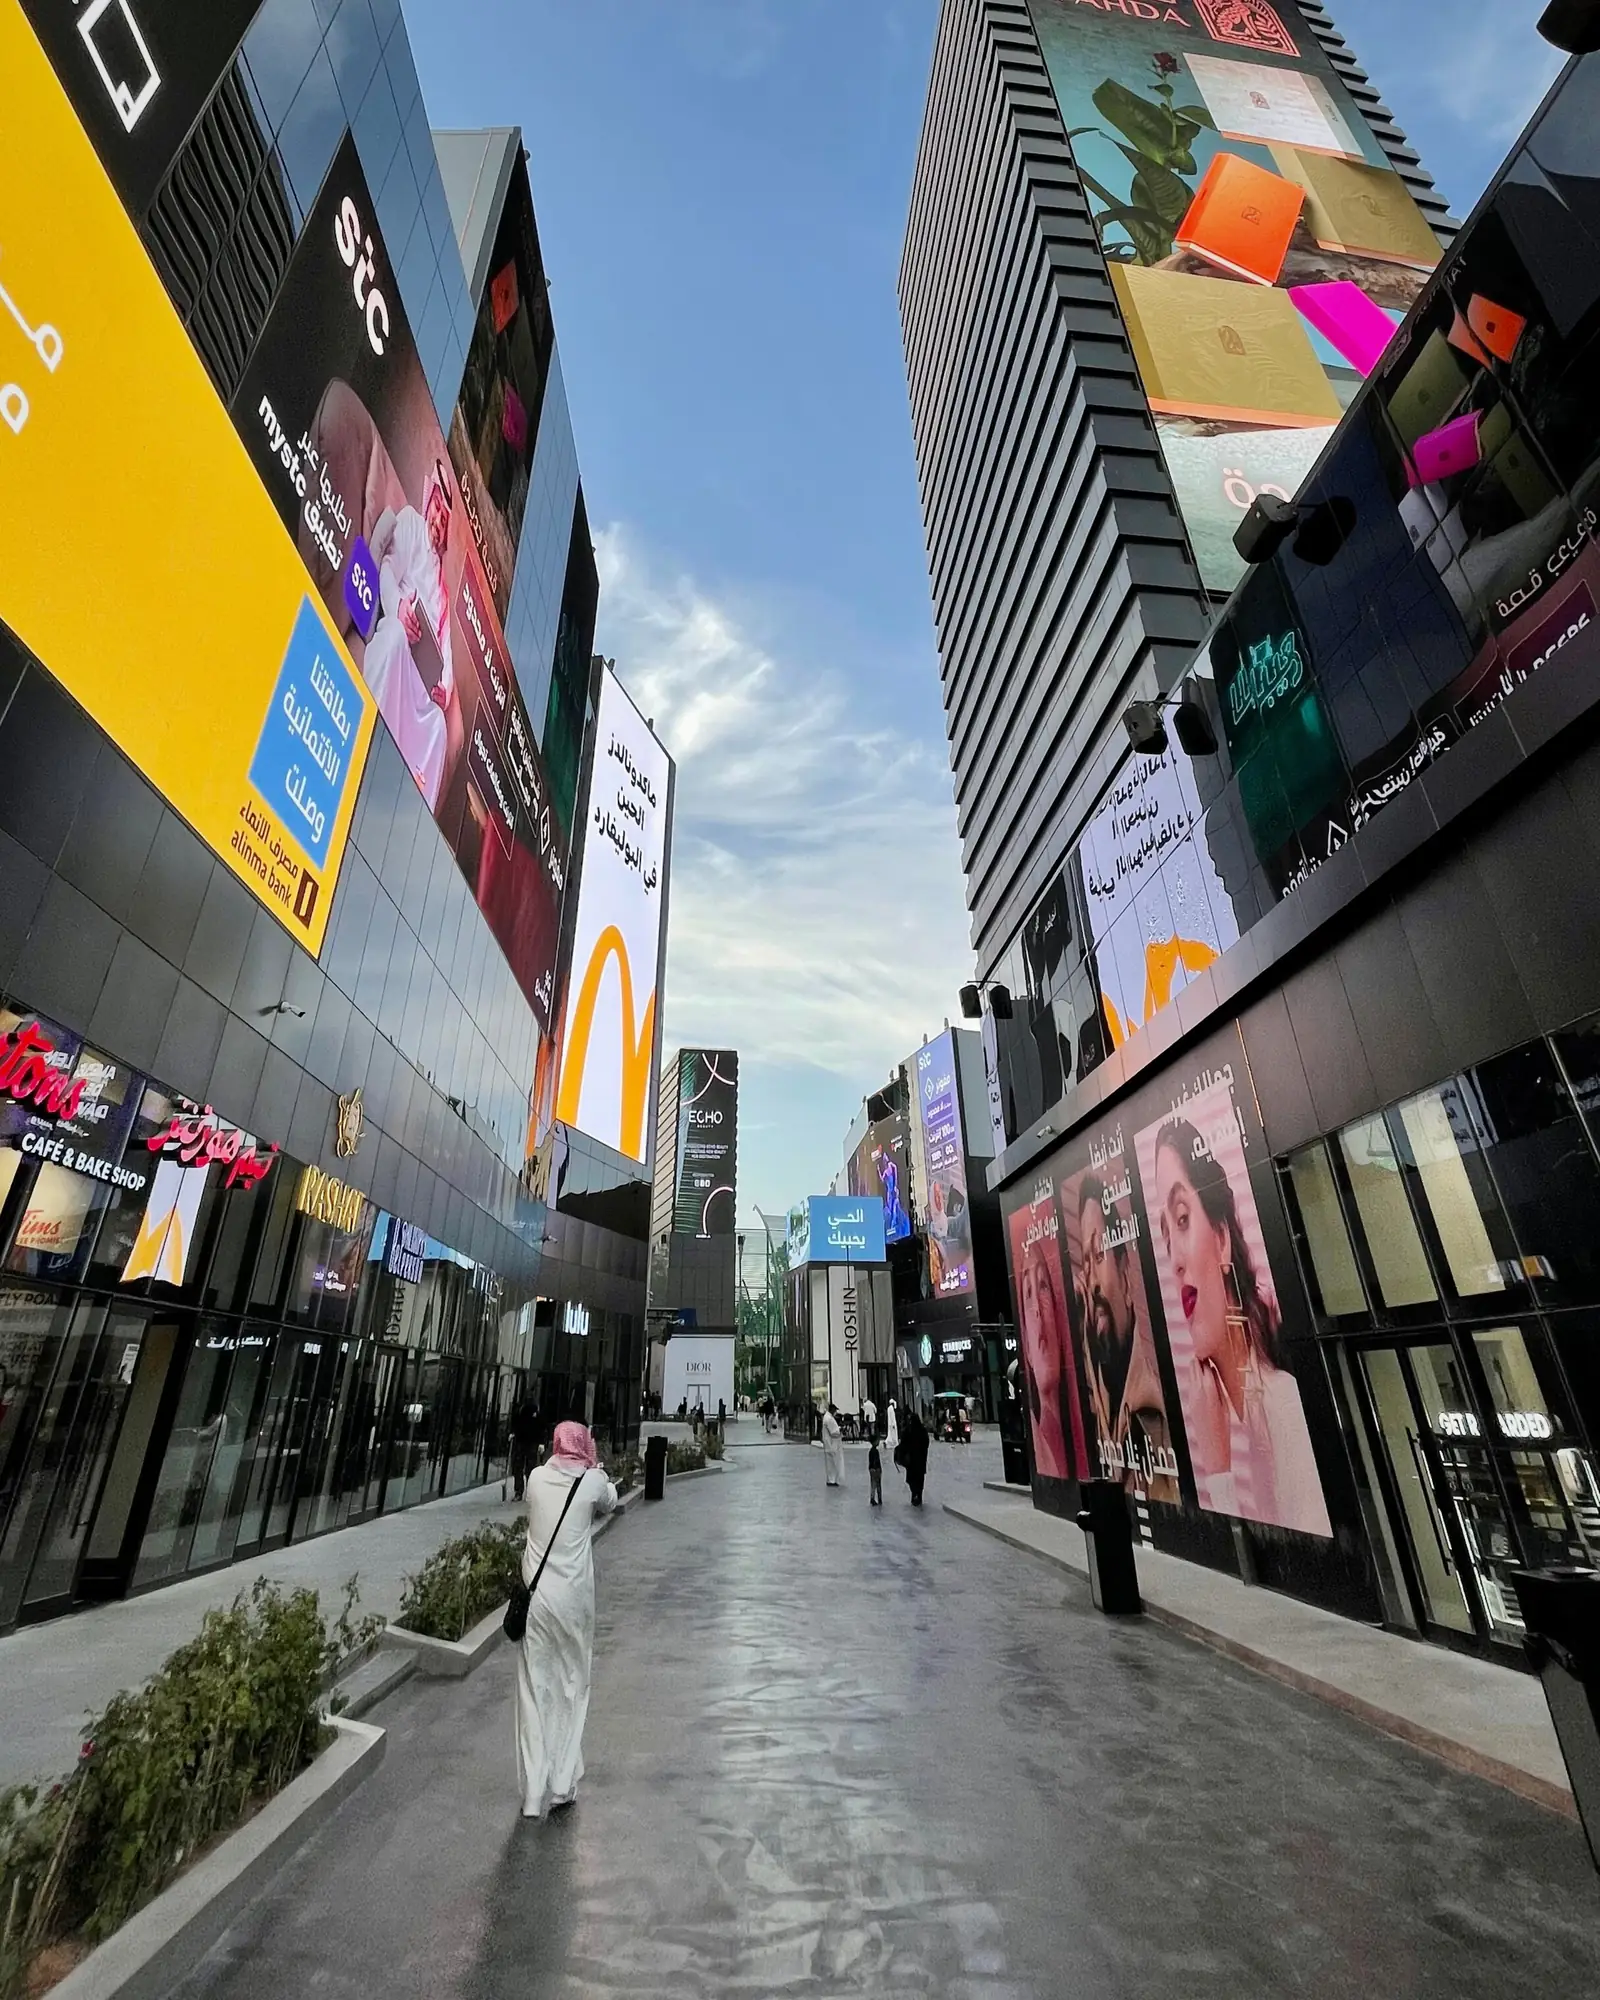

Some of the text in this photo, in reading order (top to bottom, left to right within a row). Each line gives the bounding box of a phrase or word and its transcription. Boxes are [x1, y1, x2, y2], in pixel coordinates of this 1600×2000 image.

[334, 196, 390, 356] stc
[258, 396, 343, 571] تطبيق mystc
[352, 562, 373, 611] stc
[463, 582, 486, 652] محدود
[310, 654, 351, 747] بطاقتنا
[608, 733, 657, 808] ماكدونالدز
[286, 763, 325, 844] وصلت
[617, 787, 645, 831] الحين
[231, 829, 293, 909] alinma bank
[269, 836, 299, 880] مصرف
[595, 807, 657, 895] في البوليفارد
[0, 1021, 87, 1121] tons
[689, 1110, 723, 1124] ECHO
[21, 1132, 146, 1191] CAFÉ & BAKE SHOP
[1101, 1168, 1133, 1216] تستحق
[828, 1209, 864, 1229] الحي
[843, 1287, 858, 1351] ROSHN
[686, 1362, 711, 1372] DIOR
[1438, 1412, 1553, 1439] GET RARDED
